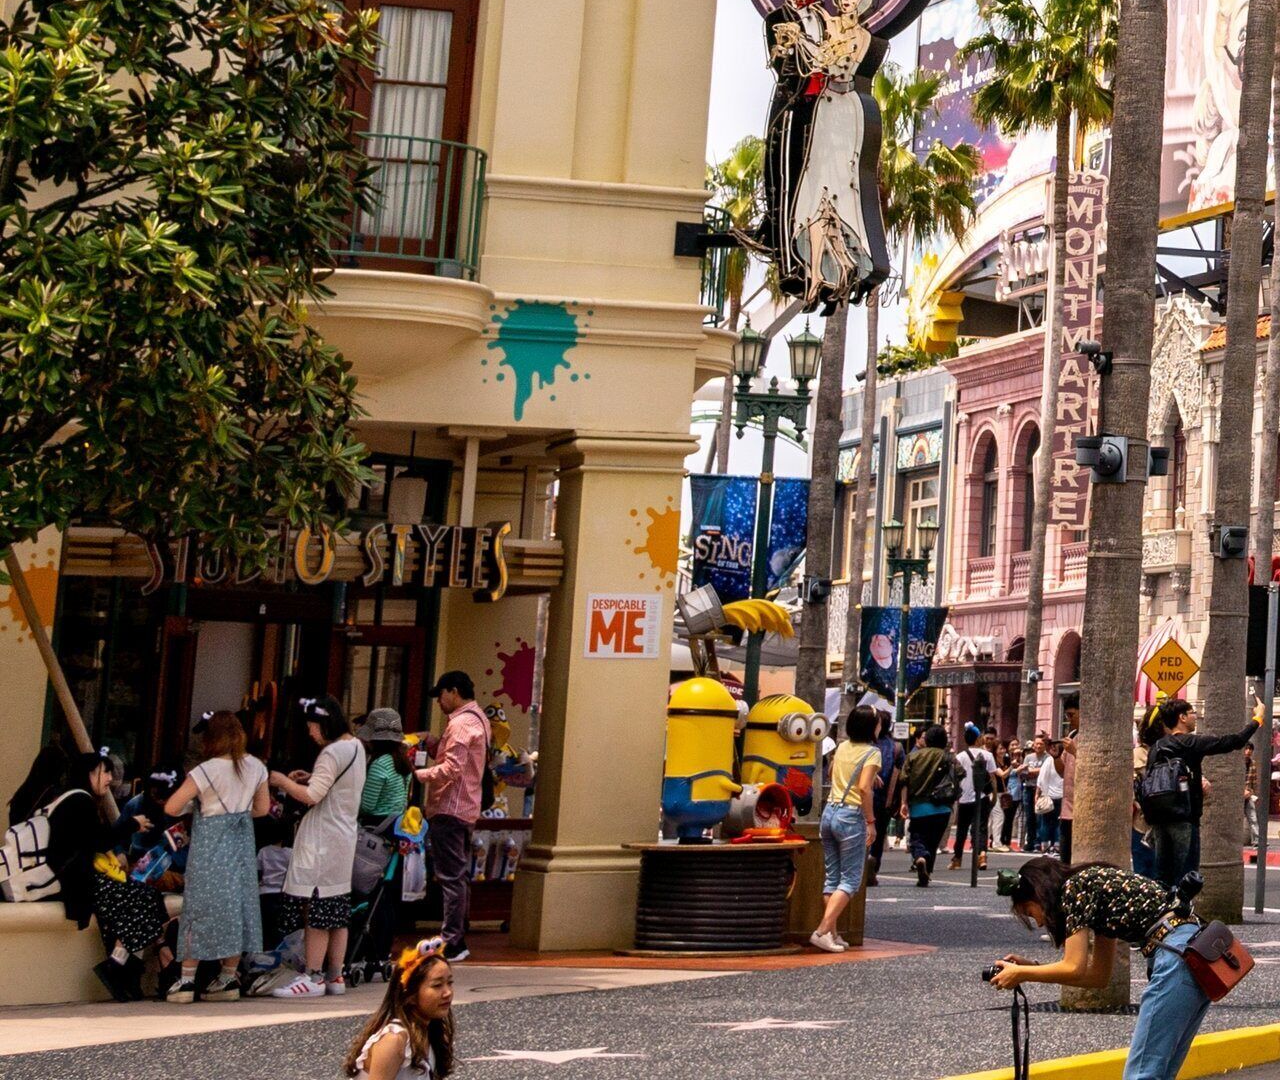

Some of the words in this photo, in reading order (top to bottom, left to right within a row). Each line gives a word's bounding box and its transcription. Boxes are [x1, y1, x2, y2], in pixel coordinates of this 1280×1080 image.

[1051, 196, 1095, 520] MONTMARTRE
[363, 522, 512, 603] STYLES
[695, 534, 752, 567] SING
[592, 599, 647, 611] DESPICABLE
[589, 611, 646, 653] ME
[1157, 671, 1184, 682] XING
[1160, 656, 1183, 667] PED
